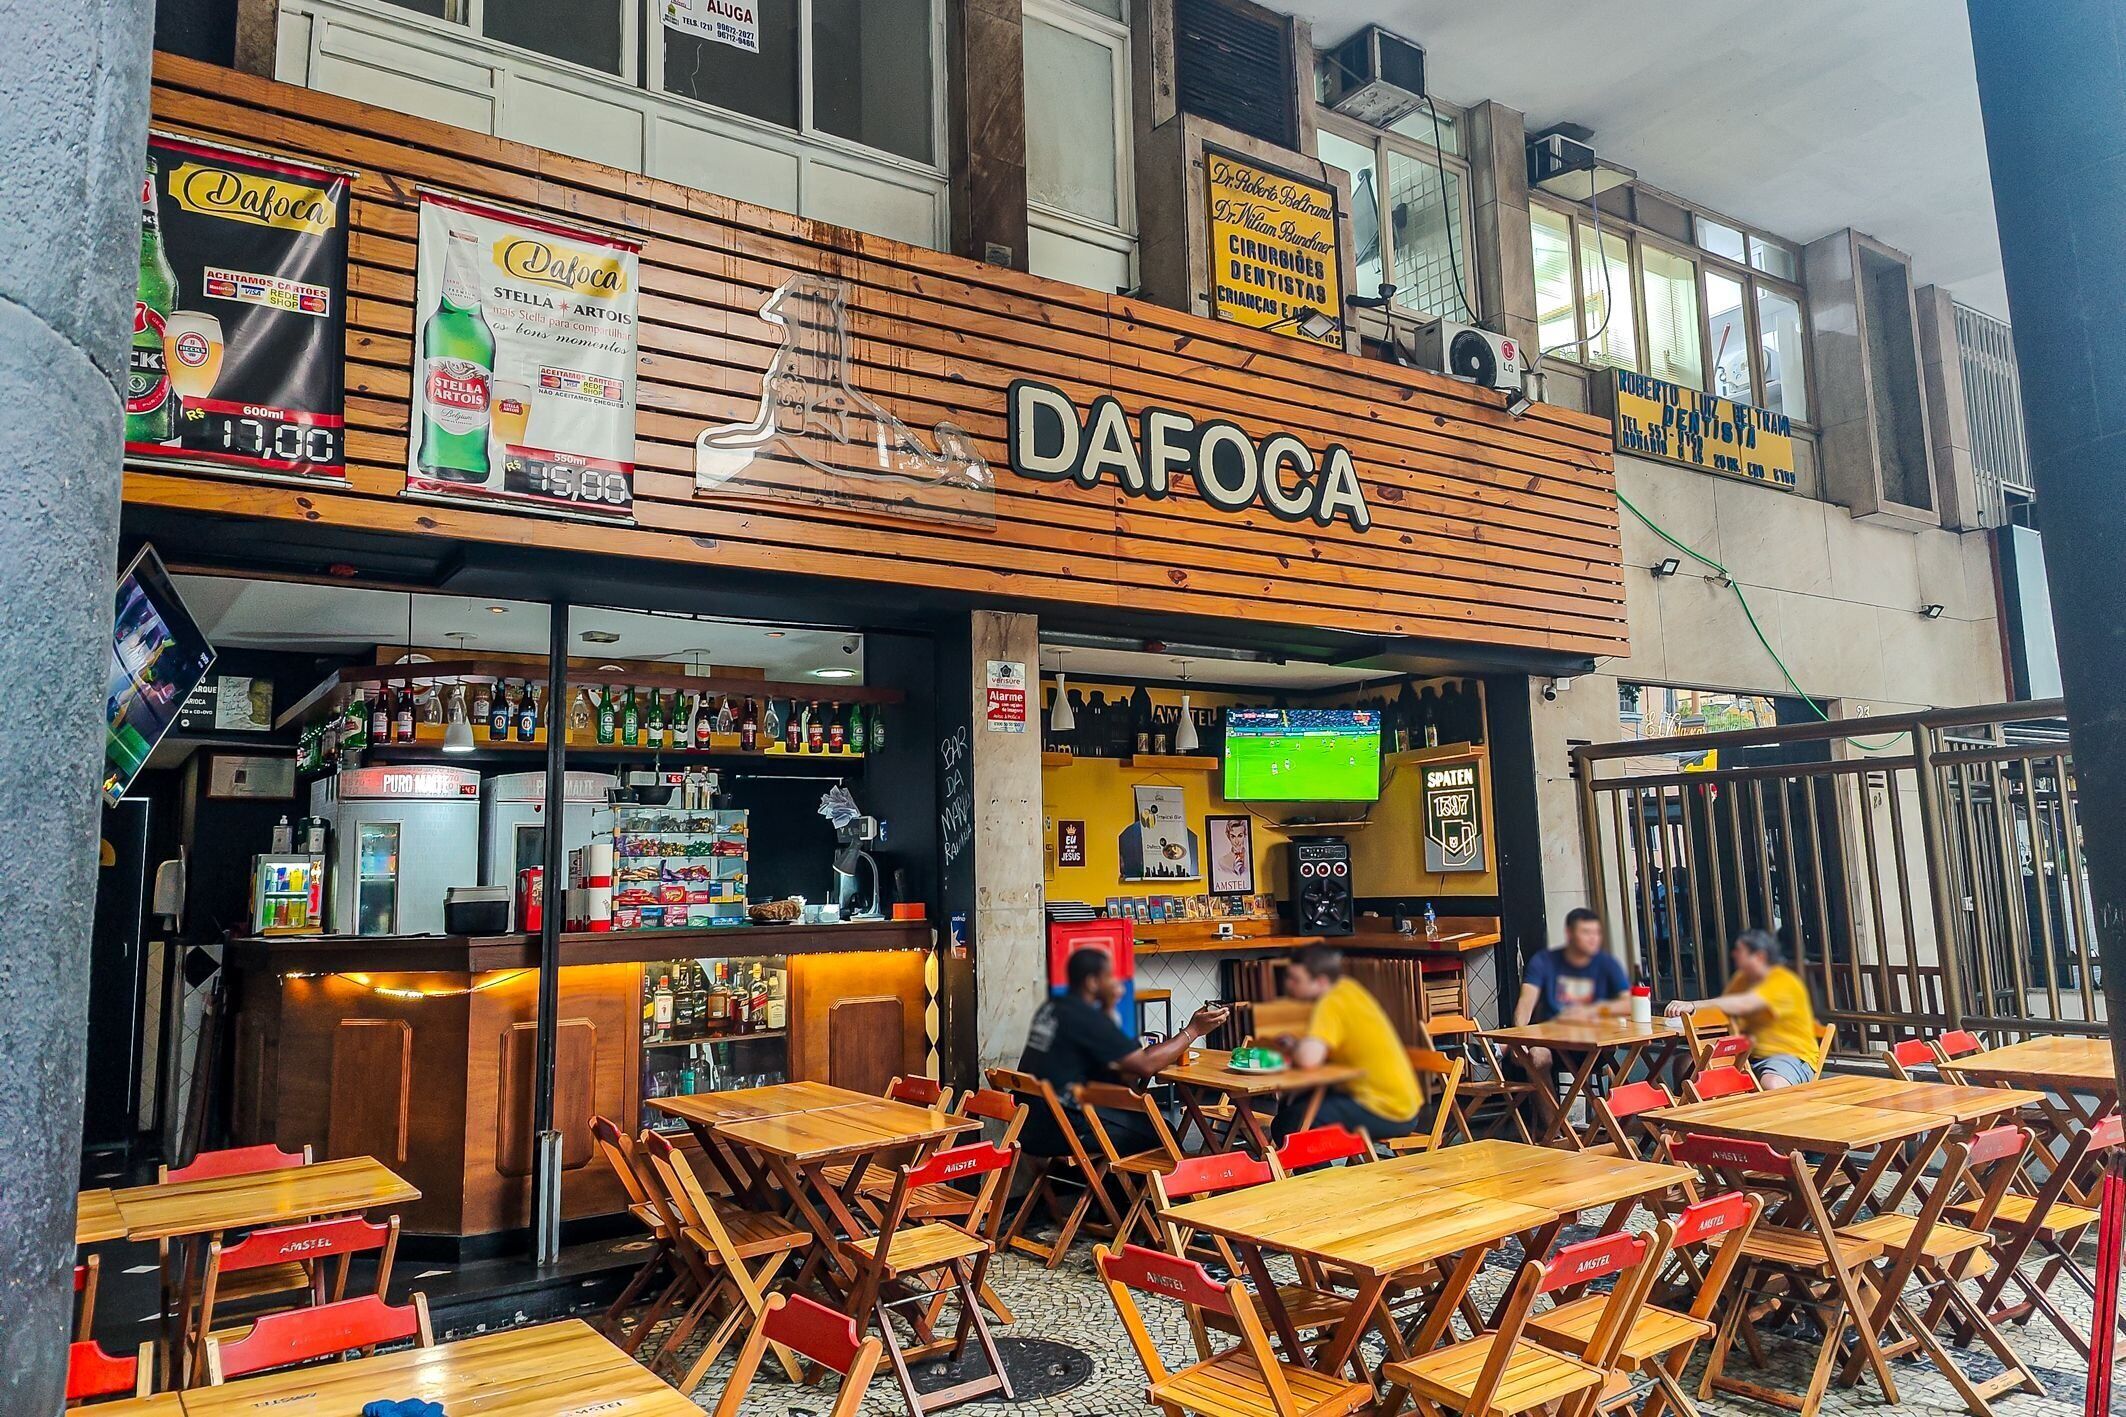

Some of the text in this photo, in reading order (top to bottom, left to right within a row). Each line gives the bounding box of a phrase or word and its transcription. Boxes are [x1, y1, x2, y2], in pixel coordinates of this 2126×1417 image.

[707, 0, 754, 24] ALUGA
[183, 168, 329, 224] Dafoca
[1212, 162, 1333, 221] Dr. Roberto Beltrami
[1213, 199, 1236, 224] Dr.
[504, 239, 622, 291] Dafoca
[1229, 234, 1325, 281] CIRURGIÕES
[207, 270, 273, 288] ACEITAMOS
[1230, 259, 1327, 305] DENTISTAS
[245, 288, 261, 297] VISA
[270, 288, 299, 301] REDE
[1217, 284, 1278, 316] CRIANÇAS
[1281, 302, 1289, 319] E
[270, 297, 299, 309] SHOP
[493, 286, 554, 309] STELLA
[573, 304, 632, 325] ARTOIS
[493, 306, 631, 340] mais Stella para compartilhar
[493, 321, 630, 355] os bons momentos
[541, 367, 586, 380] ACEITAMOS
[1503, 362, 1514, 373] LG
[434, 376, 483, 394] STELLA
[583, 381, 604, 390] REDE
[583, 387, 603, 396] SHOP
[434, 388, 483, 406] ARTOIS
[555, 391, 593, 403] ACEITAMOS
[594, 398, 624, 408] CHEQUES
[1618, 369, 1681, 407] ROBERTO
[1690, 390, 1720, 420] LUIZ
[187, 407, 205, 422] R$
[243, 406, 284, 420] 600ml
[1662, 405, 1757, 449] DENTISTA
[223, 418, 334, 463] 17,00
[553, 454, 586, 466] 550ml
[1016, 383, 1372, 528] DAFOCA
[506, 459, 522, 472] R$
[991, 677, 1021, 685] verisure
[989, 690, 1023, 702] Alarme
[1153, 705, 1215, 727] AMTEL
[941, 725, 968, 770] BAR
[383, 774, 413, 793] PURO
[945, 768, 965, 798] DA
[1427, 768, 1474, 788] SPATEN
[1065, 835, 1077, 845] EU
[1061, 852, 1081, 861] JESUS
[1215, 880, 1247, 891] AMSTEL
[944, 1158, 977, 1174] AMSTEL
[1698, 1214, 1725, 1232] AMSTEL
[280, 1237, 333, 1254] AMSTEL
[1575, 1253, 1611, 1274] AMSTEL
[1146, 1271, 1187, 1293] AMSTEL
